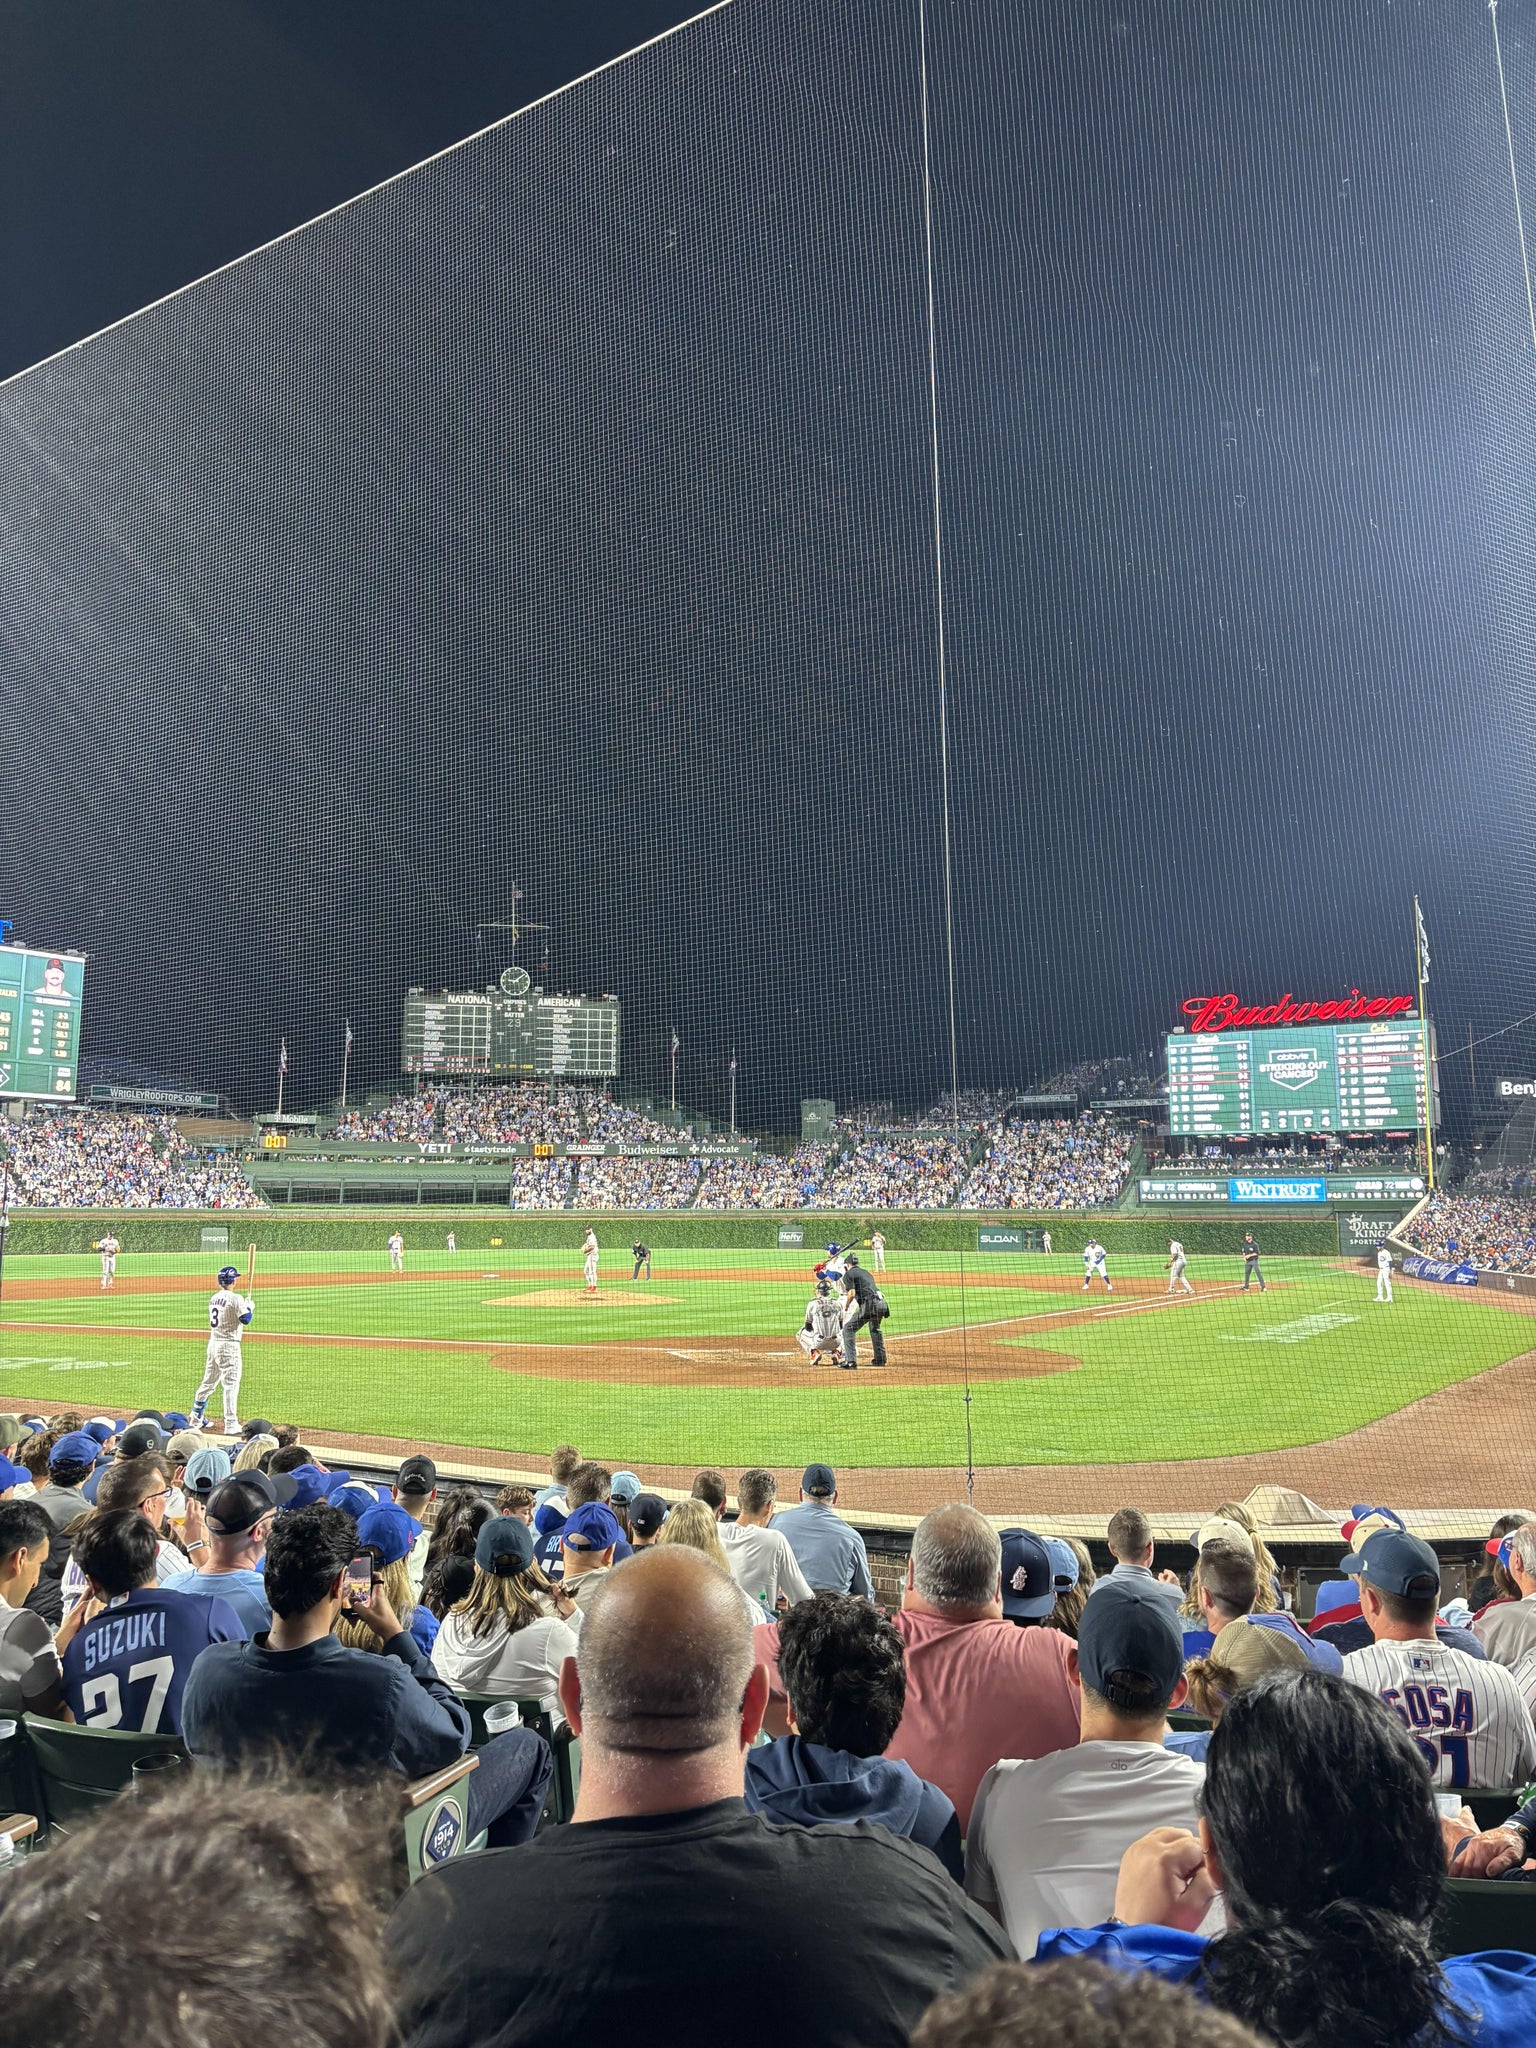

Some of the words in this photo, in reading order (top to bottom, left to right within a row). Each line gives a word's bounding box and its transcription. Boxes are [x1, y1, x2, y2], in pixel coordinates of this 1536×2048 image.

[448, 995, 492, 1004] NATIONAL
[537, 998, 581, 1007] AMERICAN
[1181, 989, 1413, 1032] Budweiser
[507, 1019, 521, 1028] 29
[1277, 1053, 1309, 1061] abbvie
[1259, 1062, 1307, 1072] STRIKING
[1307, 1060, 1328, 1070] OUT
[1274, 1070, 1314, 1079] CANCER
[56, 1080, 71, 1092] 84
[282, 1114, 308, 1123] Mobile
[1261, 1118, 1270, 1128] 2
[1278, 1118, 1287, 1128] 2
[1304, 1117, 1312, 1127] 2
[1321, 1116, 1330, 1127] 4
[265, 1136, 287, 1148] 0:07
[418, 1143, 451, 1153] YETI
[471, 1144, 517, 1155] tastytrade
[534, 1144, 554, 1155] 0:07
[700, 1144, 739, 1153] Advocate
[1236, 1181, 1321, 1196] WINTRUST
[1349, 1221, 1394, 1231] DRAFT
[780, 1233, 802, 1241] Hefty
[84, 1612, 165, 1671] SUZUKI
[82, 1655, 174, 1734] 27
[1380, 1684, 1474, 1732] SOSA
[434, 1823, 454, 1848] 1914
